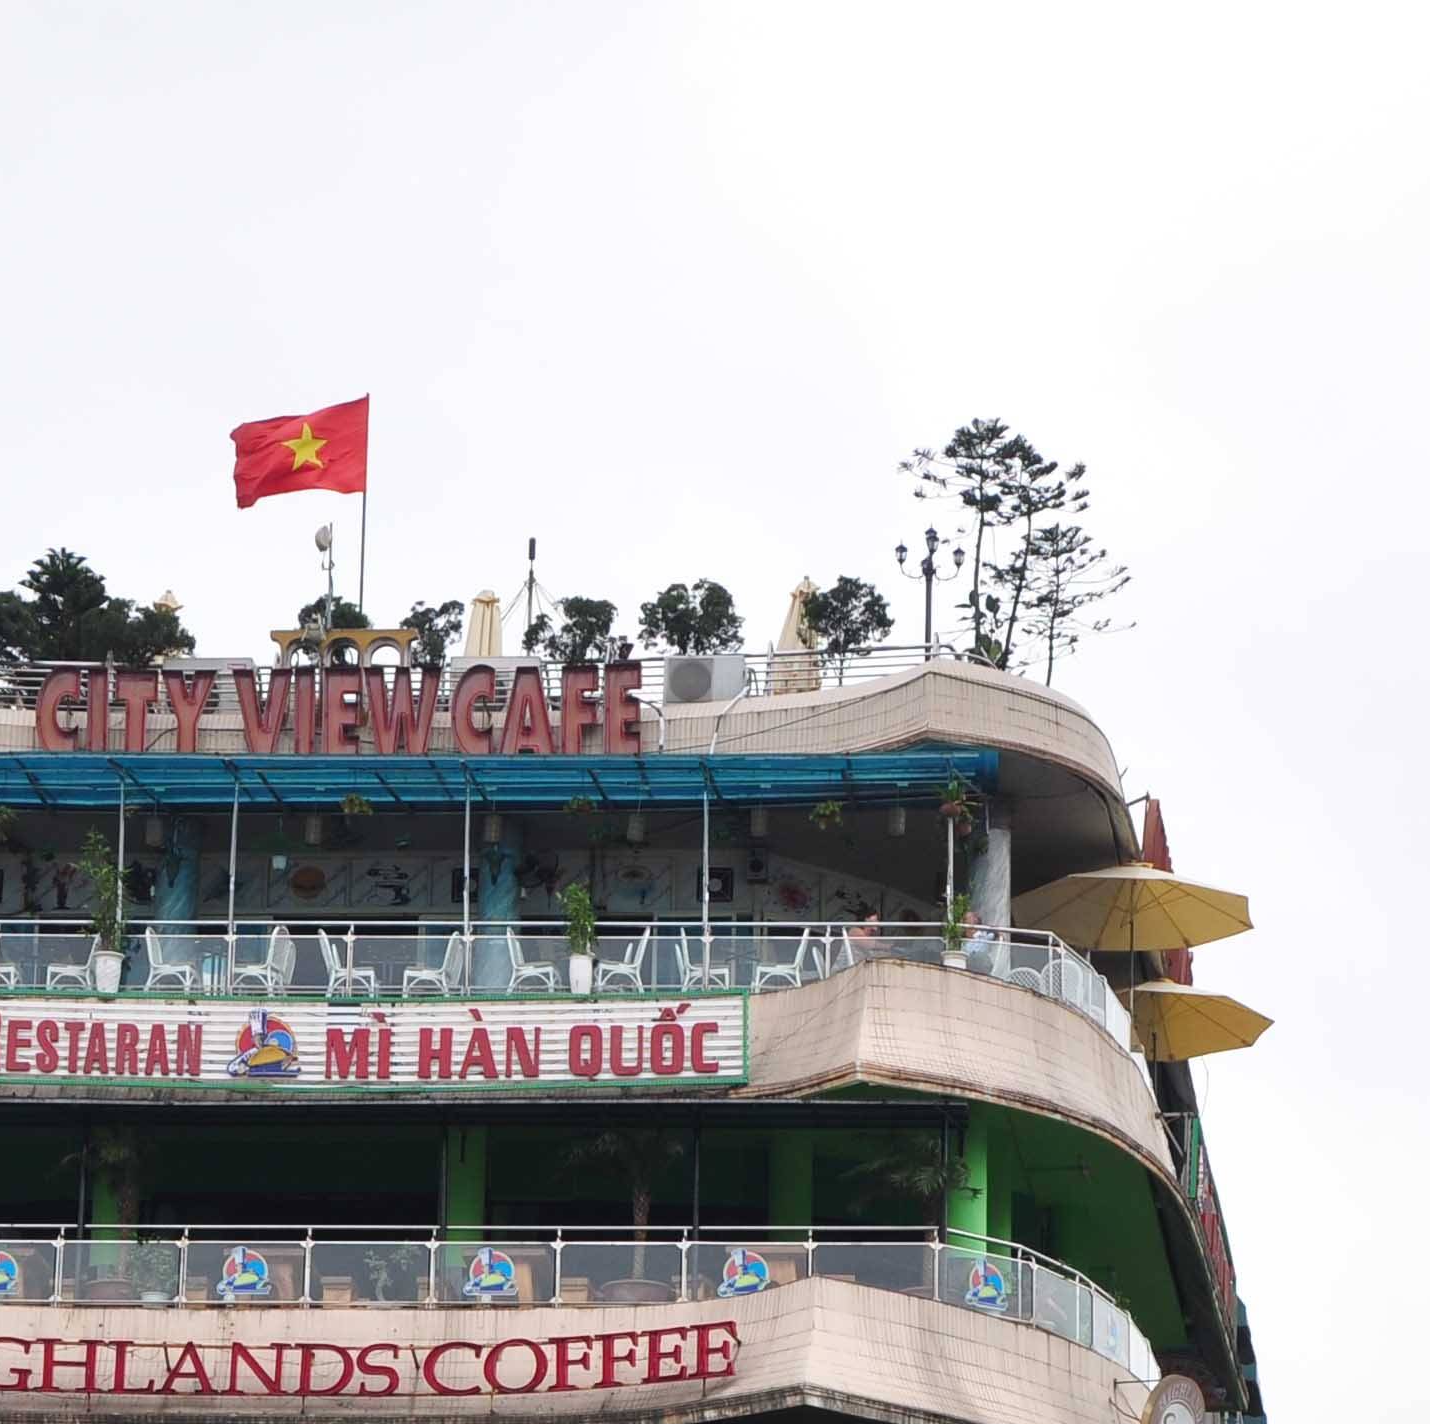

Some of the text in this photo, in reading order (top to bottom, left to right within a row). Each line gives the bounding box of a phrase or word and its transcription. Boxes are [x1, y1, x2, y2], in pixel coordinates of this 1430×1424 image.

[35, 662, 642, 753] CITY VIEW CAFE
[326, 1003, 719, 1080] MÌ HÀN QUỐC
[423, 1320, 739, 1395] COFFEE
